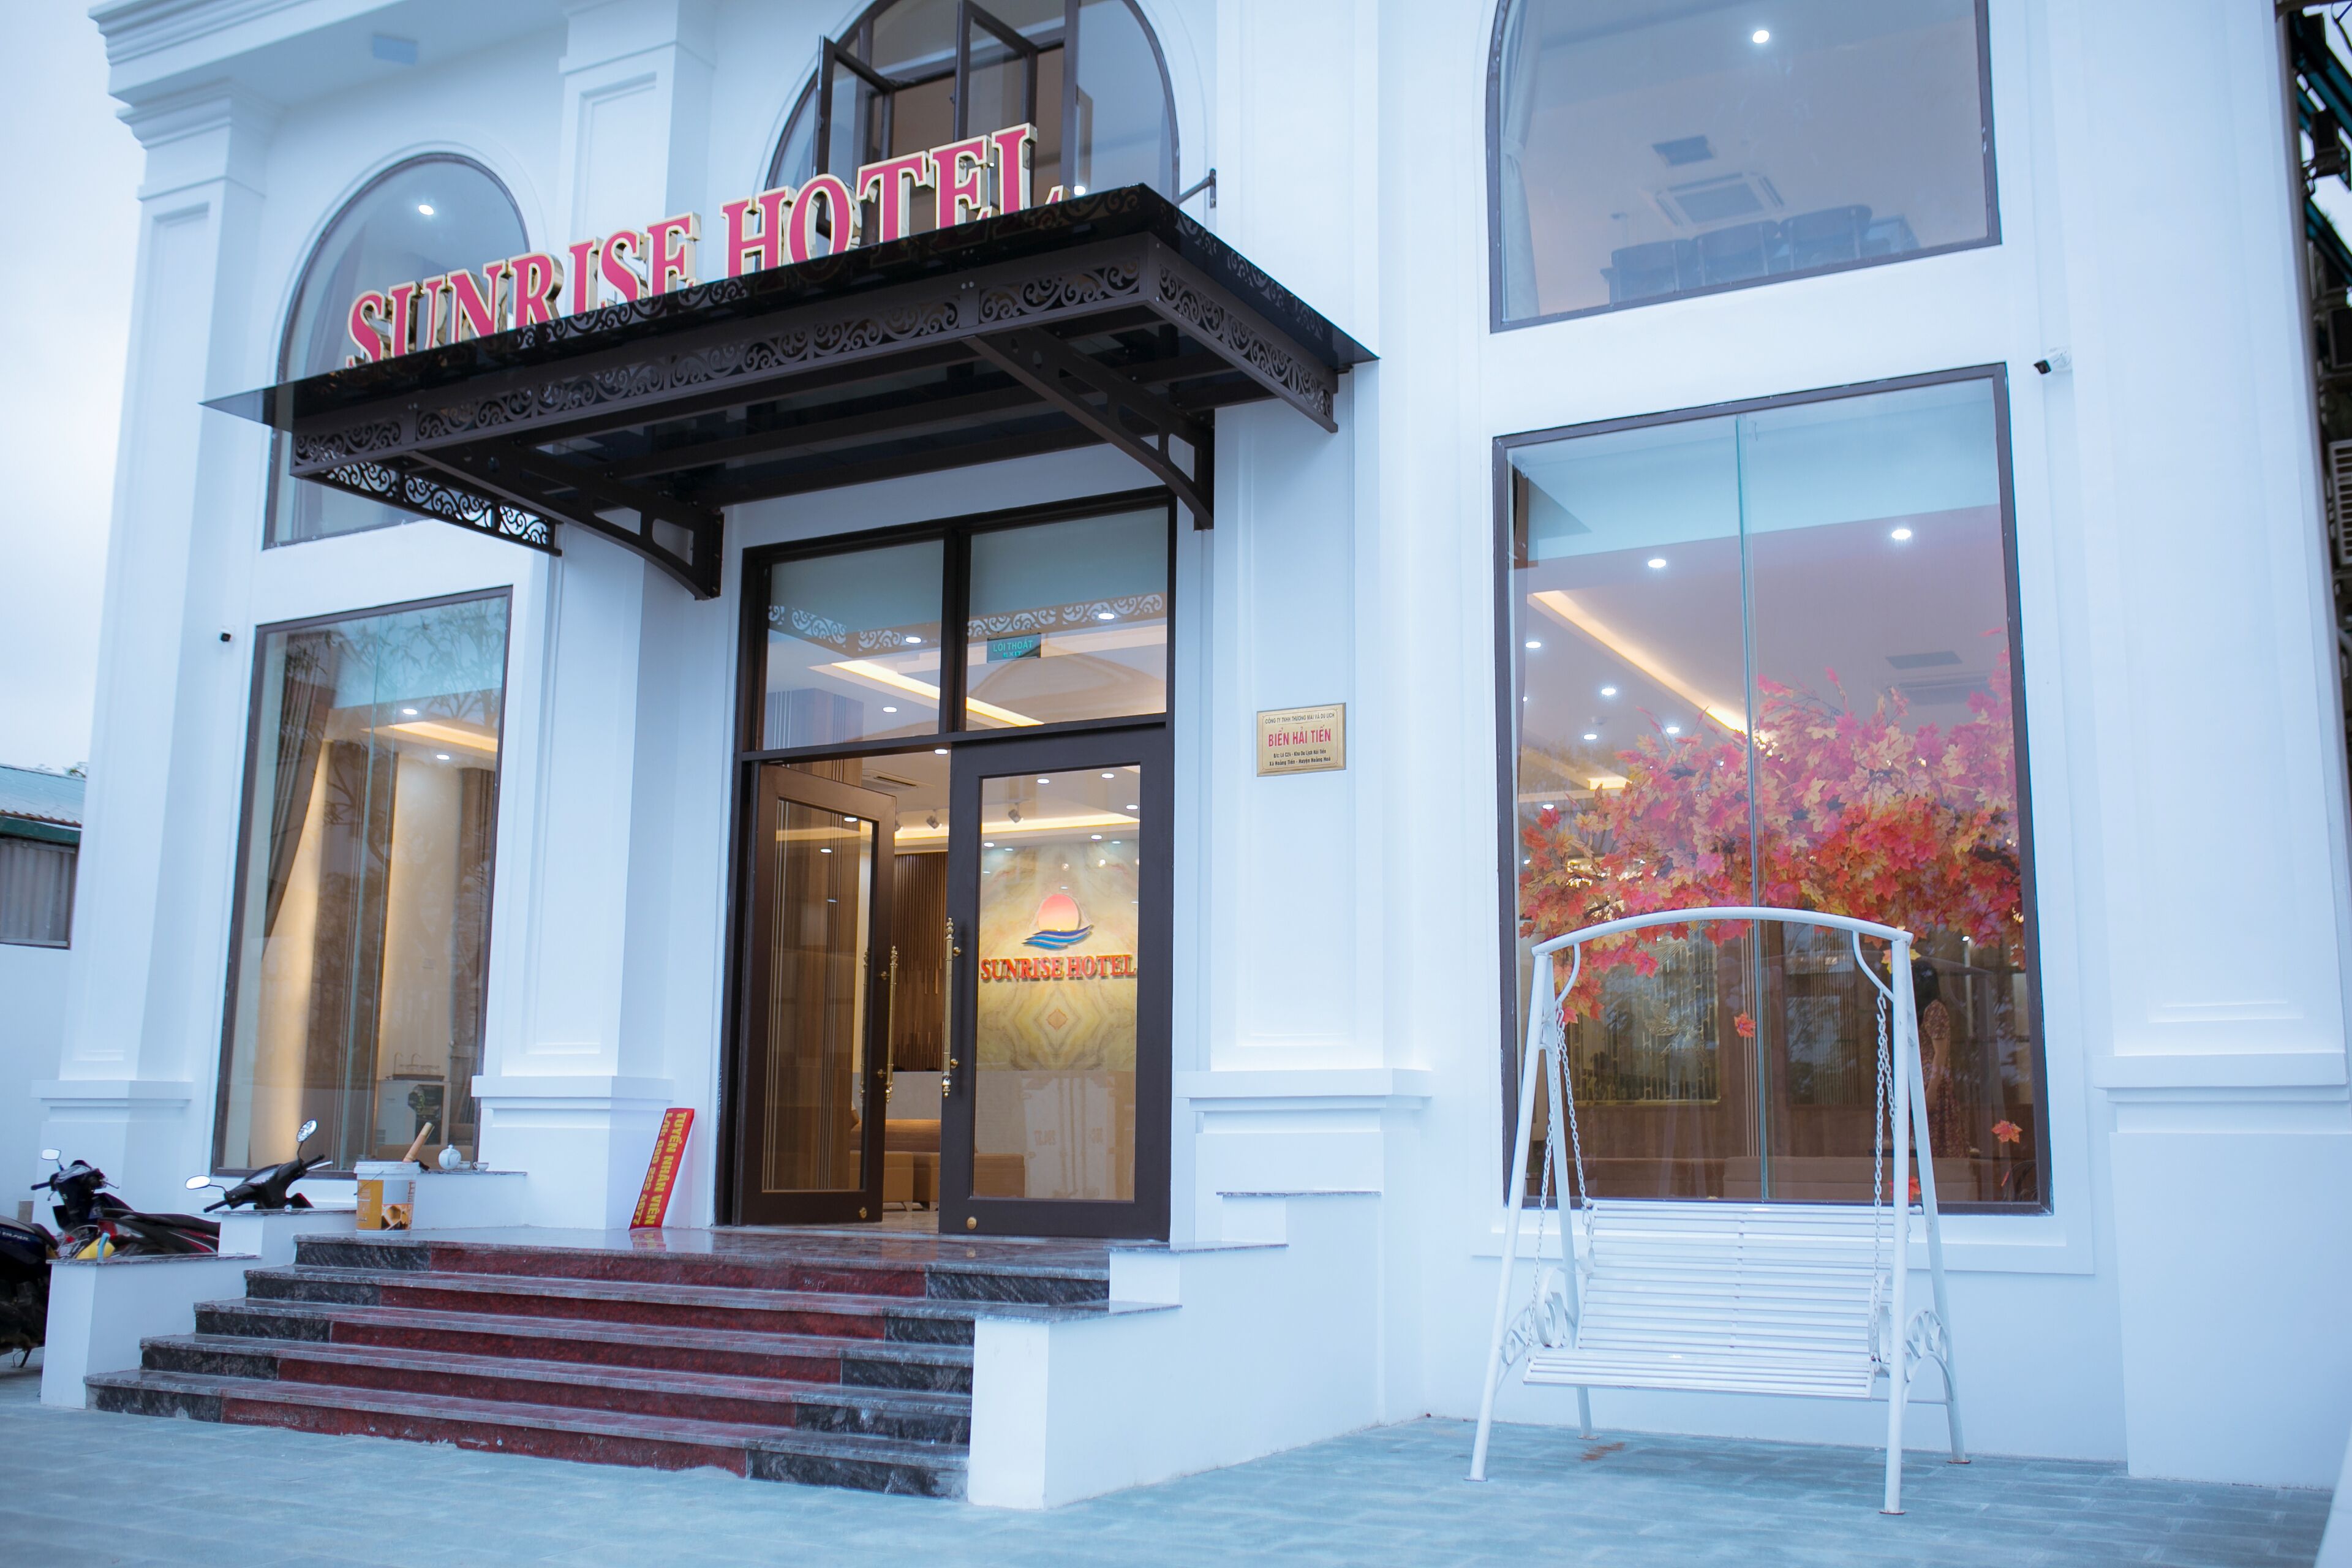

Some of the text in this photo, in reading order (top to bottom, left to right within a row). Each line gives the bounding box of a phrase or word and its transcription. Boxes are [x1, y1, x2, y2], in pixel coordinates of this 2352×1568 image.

[346, 123, 1067, 369] SUNRISE HOTEL
[1268, 725, 1331, 747] BIỂN HẢI TIẾN
[980, 954, 1137, 982] SUNRISE HOTEL
[644, 1194, 662, 1225] VIÊN
